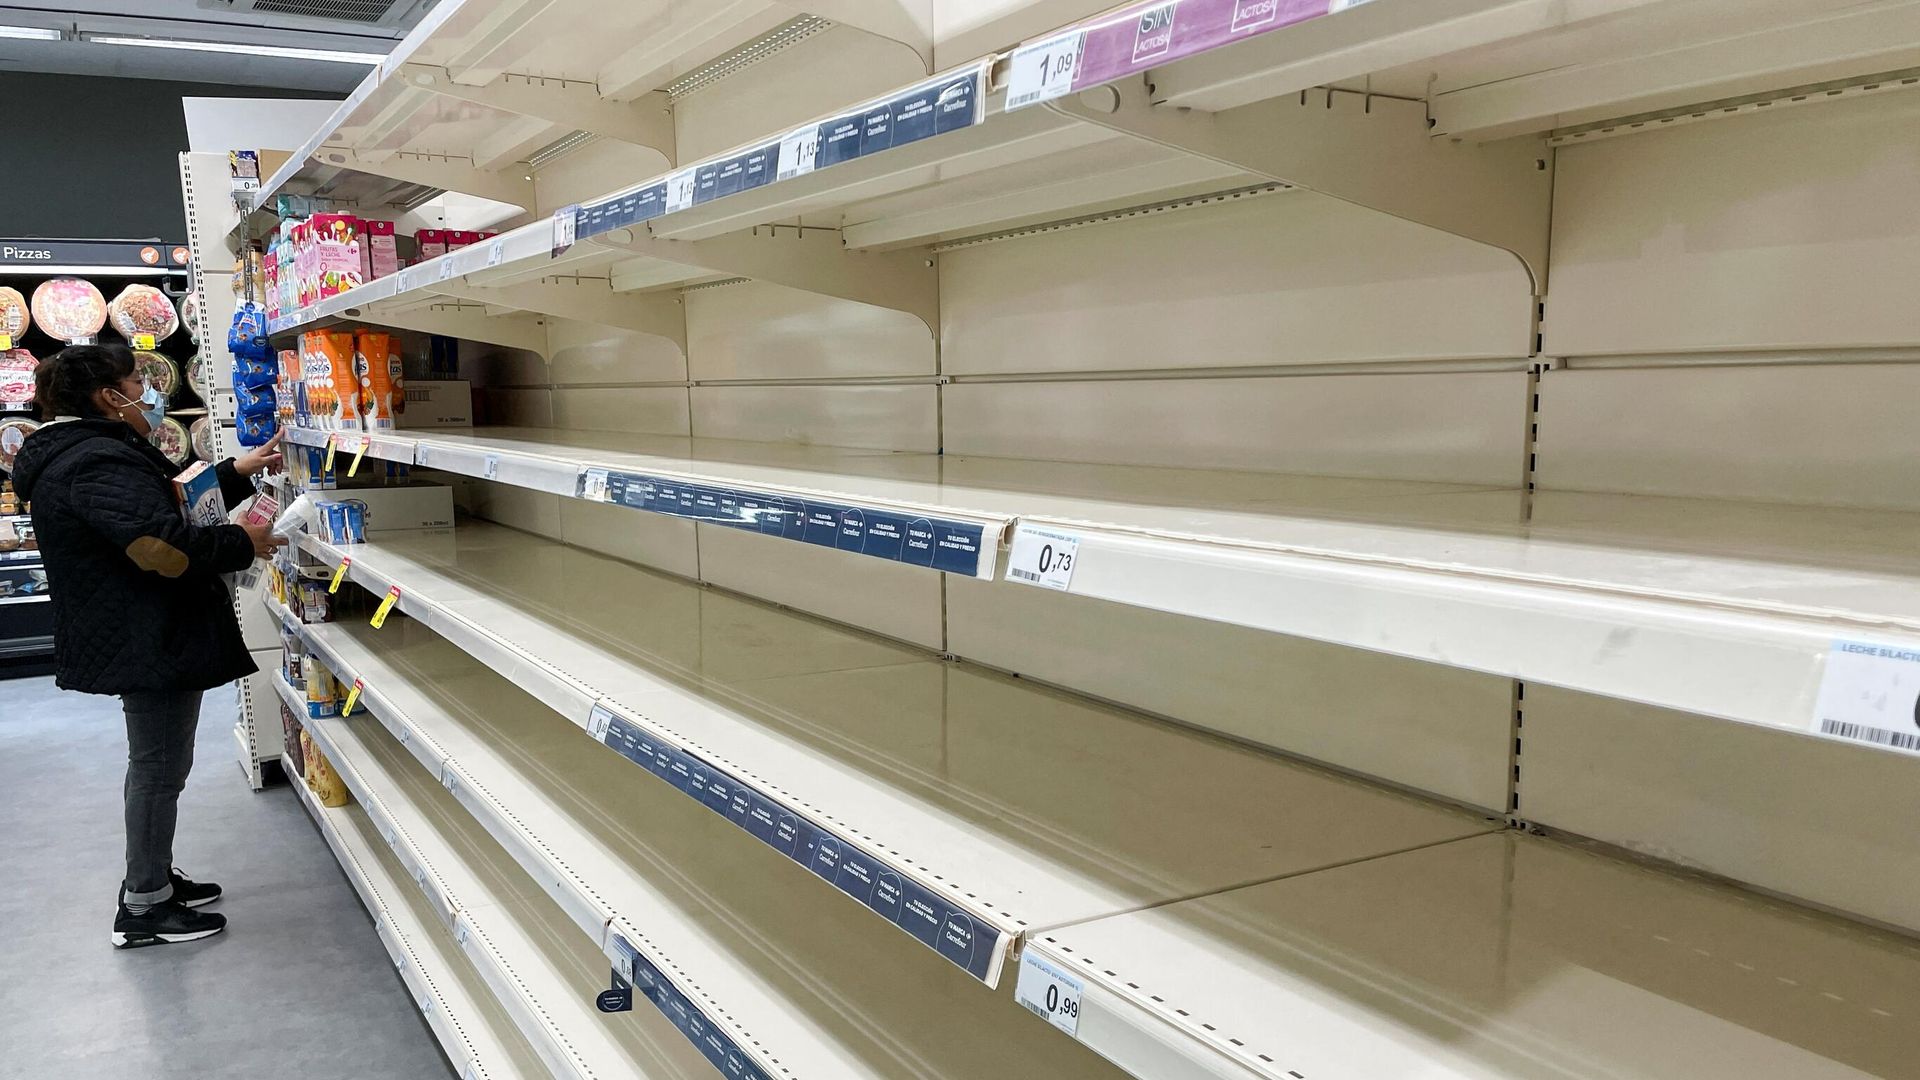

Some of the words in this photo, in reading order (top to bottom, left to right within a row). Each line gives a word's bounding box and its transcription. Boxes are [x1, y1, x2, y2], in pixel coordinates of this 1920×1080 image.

[1141, 4, 1174, 33] SIN
[1040, 53, 1073, 87] 1,09
[796, 141, 815, 166] 1,13
[3, 246, 52, 260] Pizzas
[1039, 544, 1072, 573] 0,73
[1841, 643, 1877, 656] LECHE
[946, 931, 967, 949] Carrefour
[1047, 983, 1078, 1018] 0,99
